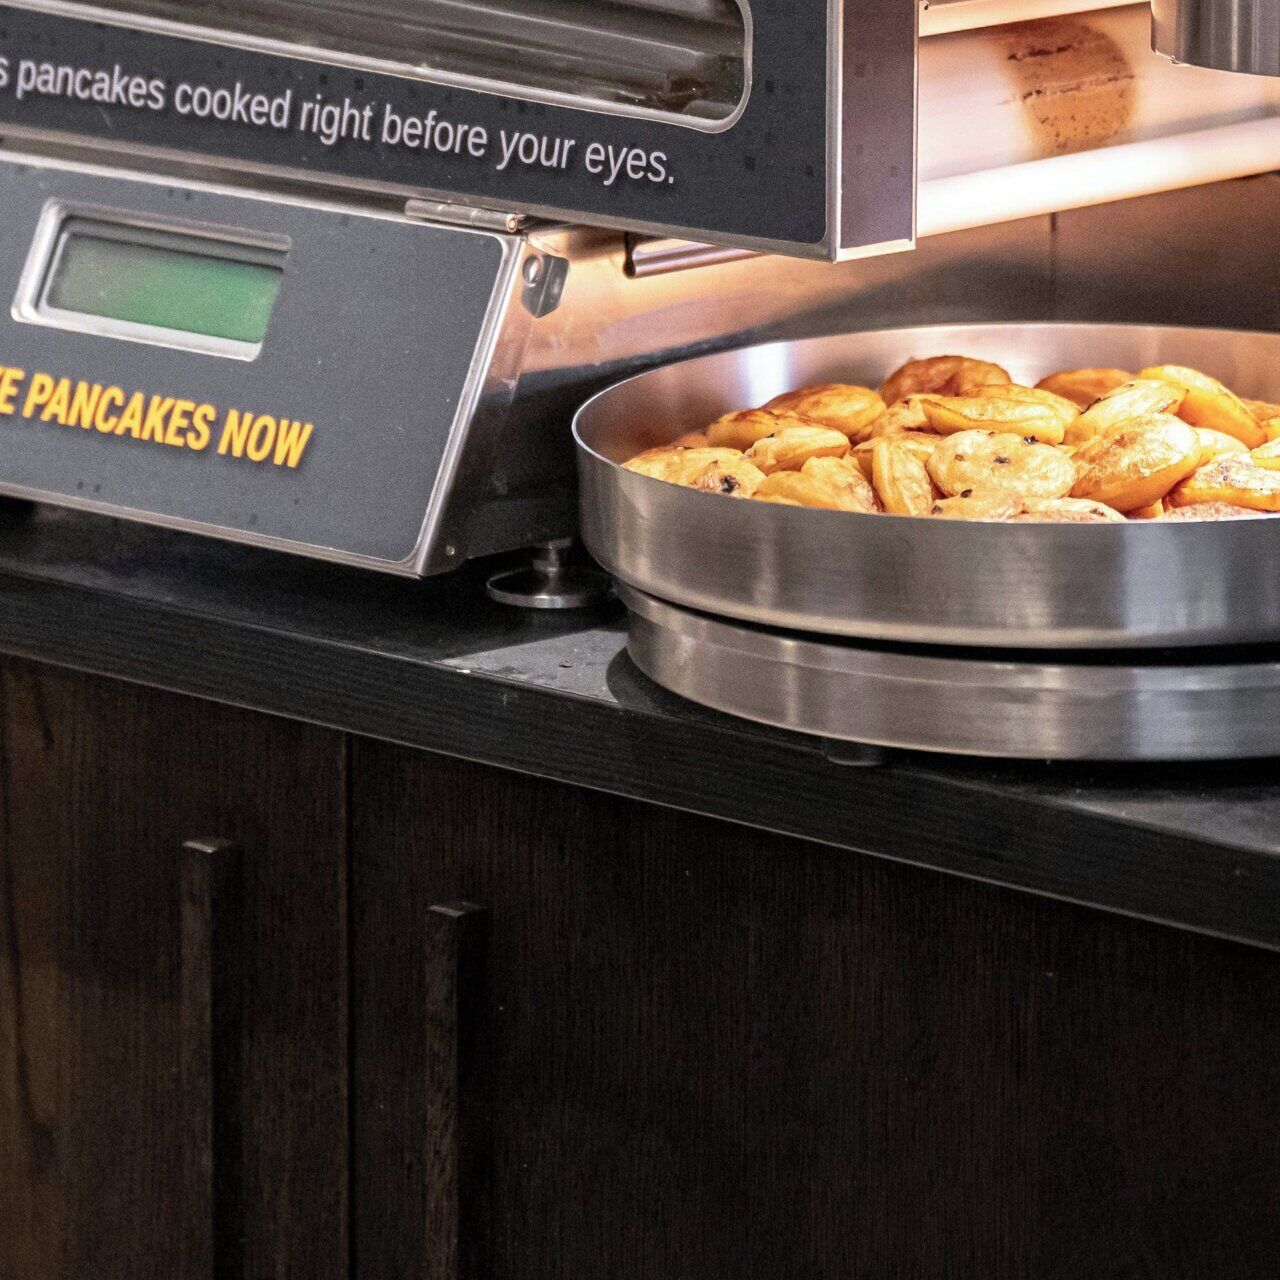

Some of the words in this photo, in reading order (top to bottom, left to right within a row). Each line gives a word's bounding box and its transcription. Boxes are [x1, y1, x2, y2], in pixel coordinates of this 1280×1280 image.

[16, 59, 165, 110] pancakes
[174, 82, 291, 128] cooked
[299, 94, 373, 145] right
[381, 104, 488, 158] before
[496, 129, 576, 170] your
[584, 141, 675, 186] eyes.
[22, 371, 216, 451] PANCAKES
[217, 407, 314, 469] NOW
